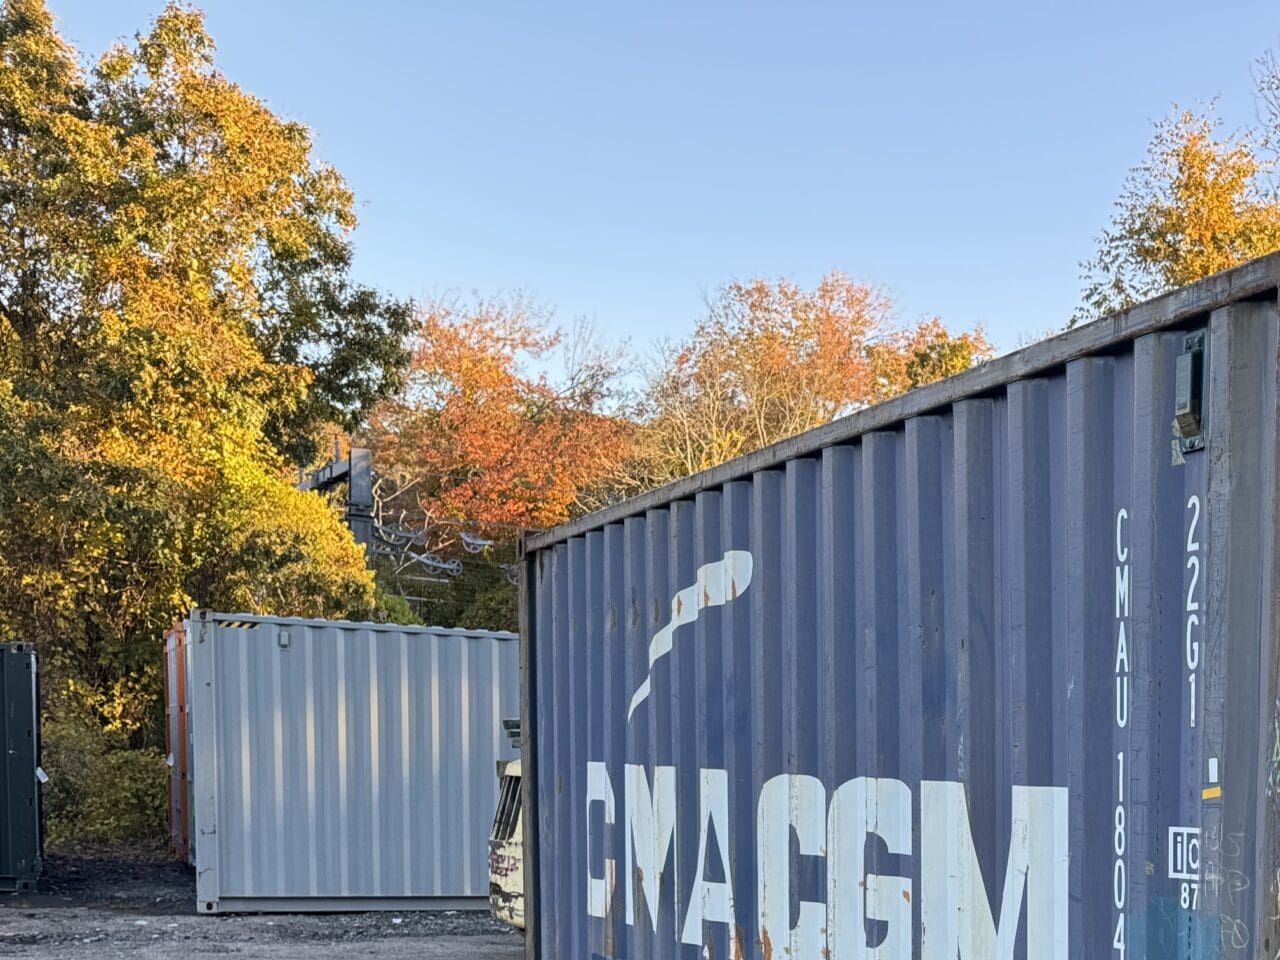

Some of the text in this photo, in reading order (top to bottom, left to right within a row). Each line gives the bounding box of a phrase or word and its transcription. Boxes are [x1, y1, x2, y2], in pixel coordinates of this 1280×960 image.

[1116, 508, 1129, 728] CMAU
[1186, 495, 1200, 727] 22G1
[1180, 882, 1199, 910] 87
